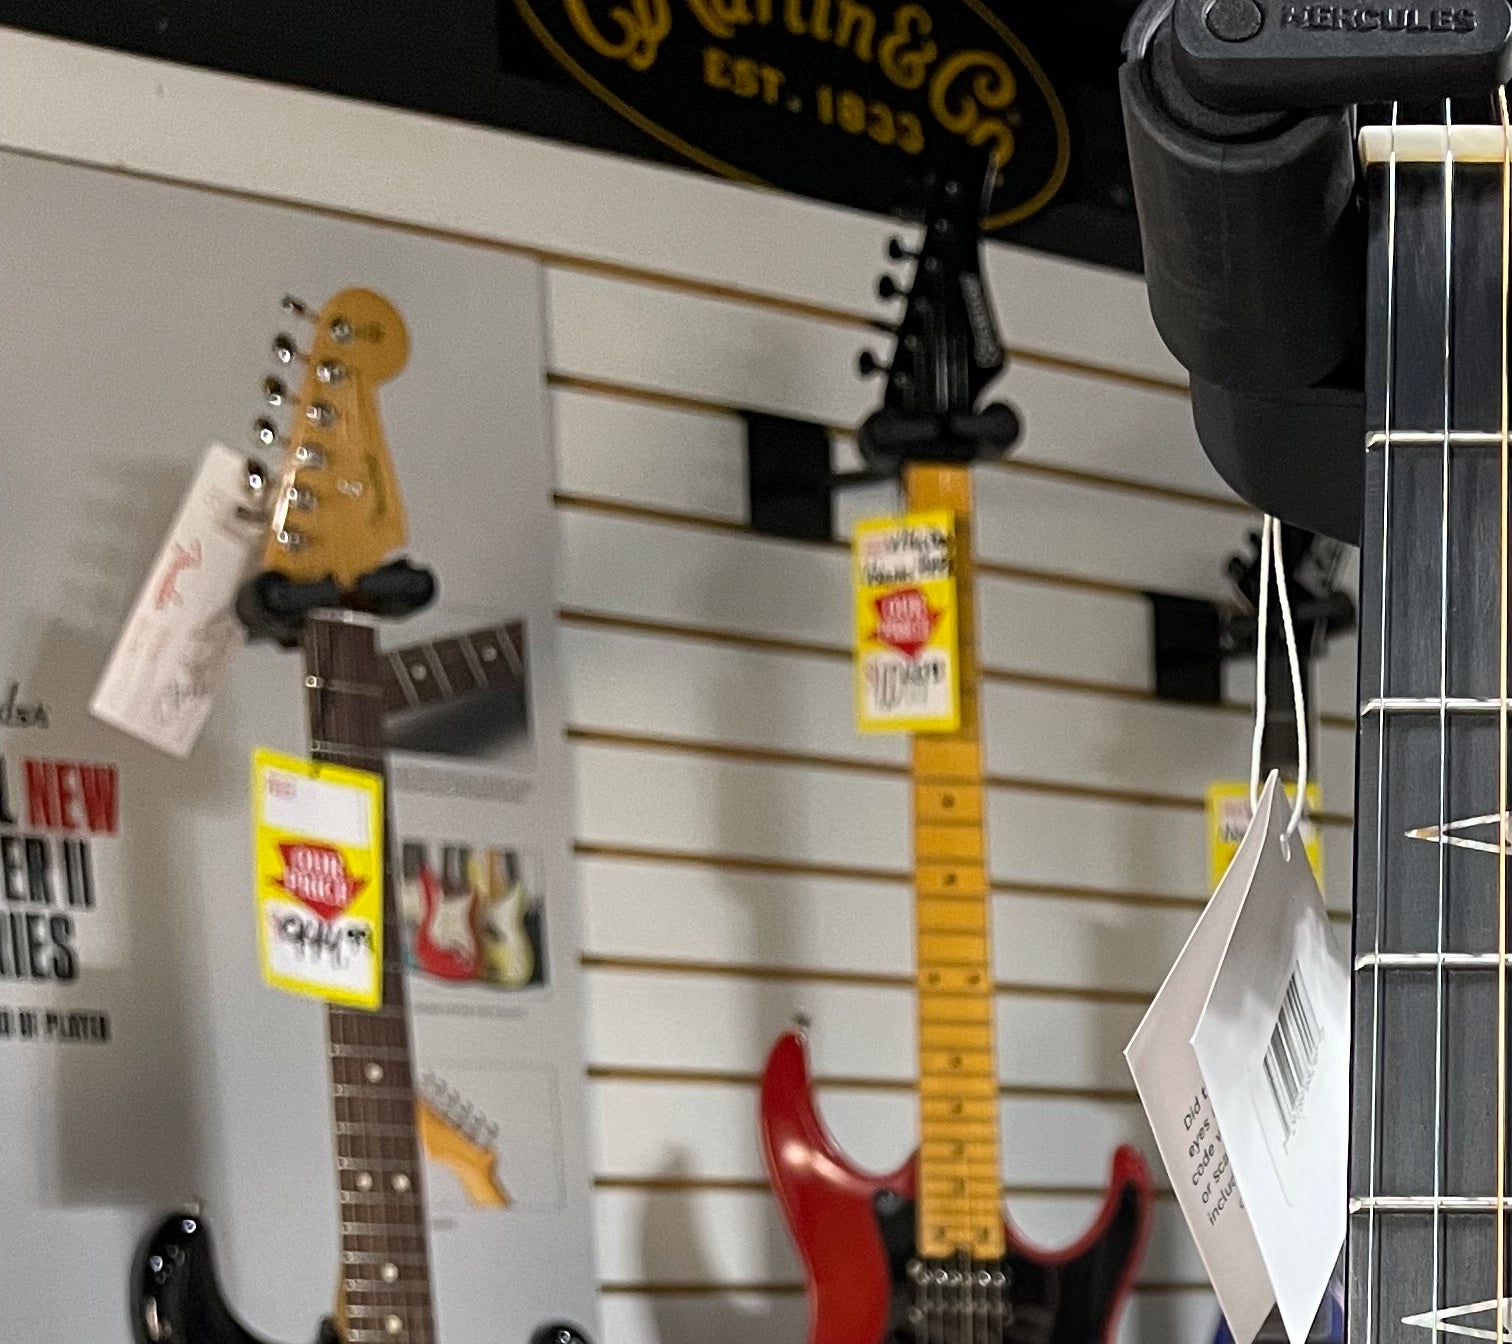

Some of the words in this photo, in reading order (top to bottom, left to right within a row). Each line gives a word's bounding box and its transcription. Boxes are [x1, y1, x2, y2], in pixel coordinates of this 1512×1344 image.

[1279, 5, 1478, 33] HERCULES
[23, 757, 119, 837] NEW
[1183, 1095, 1201, 1131] Did
[1188, 1117, 1211, 1159] eyes
[1192, 1143, 1215, 1186] code
[1201, 1182, 1213, 1204] or
[1212, 1152, 1229, 1184] sca
